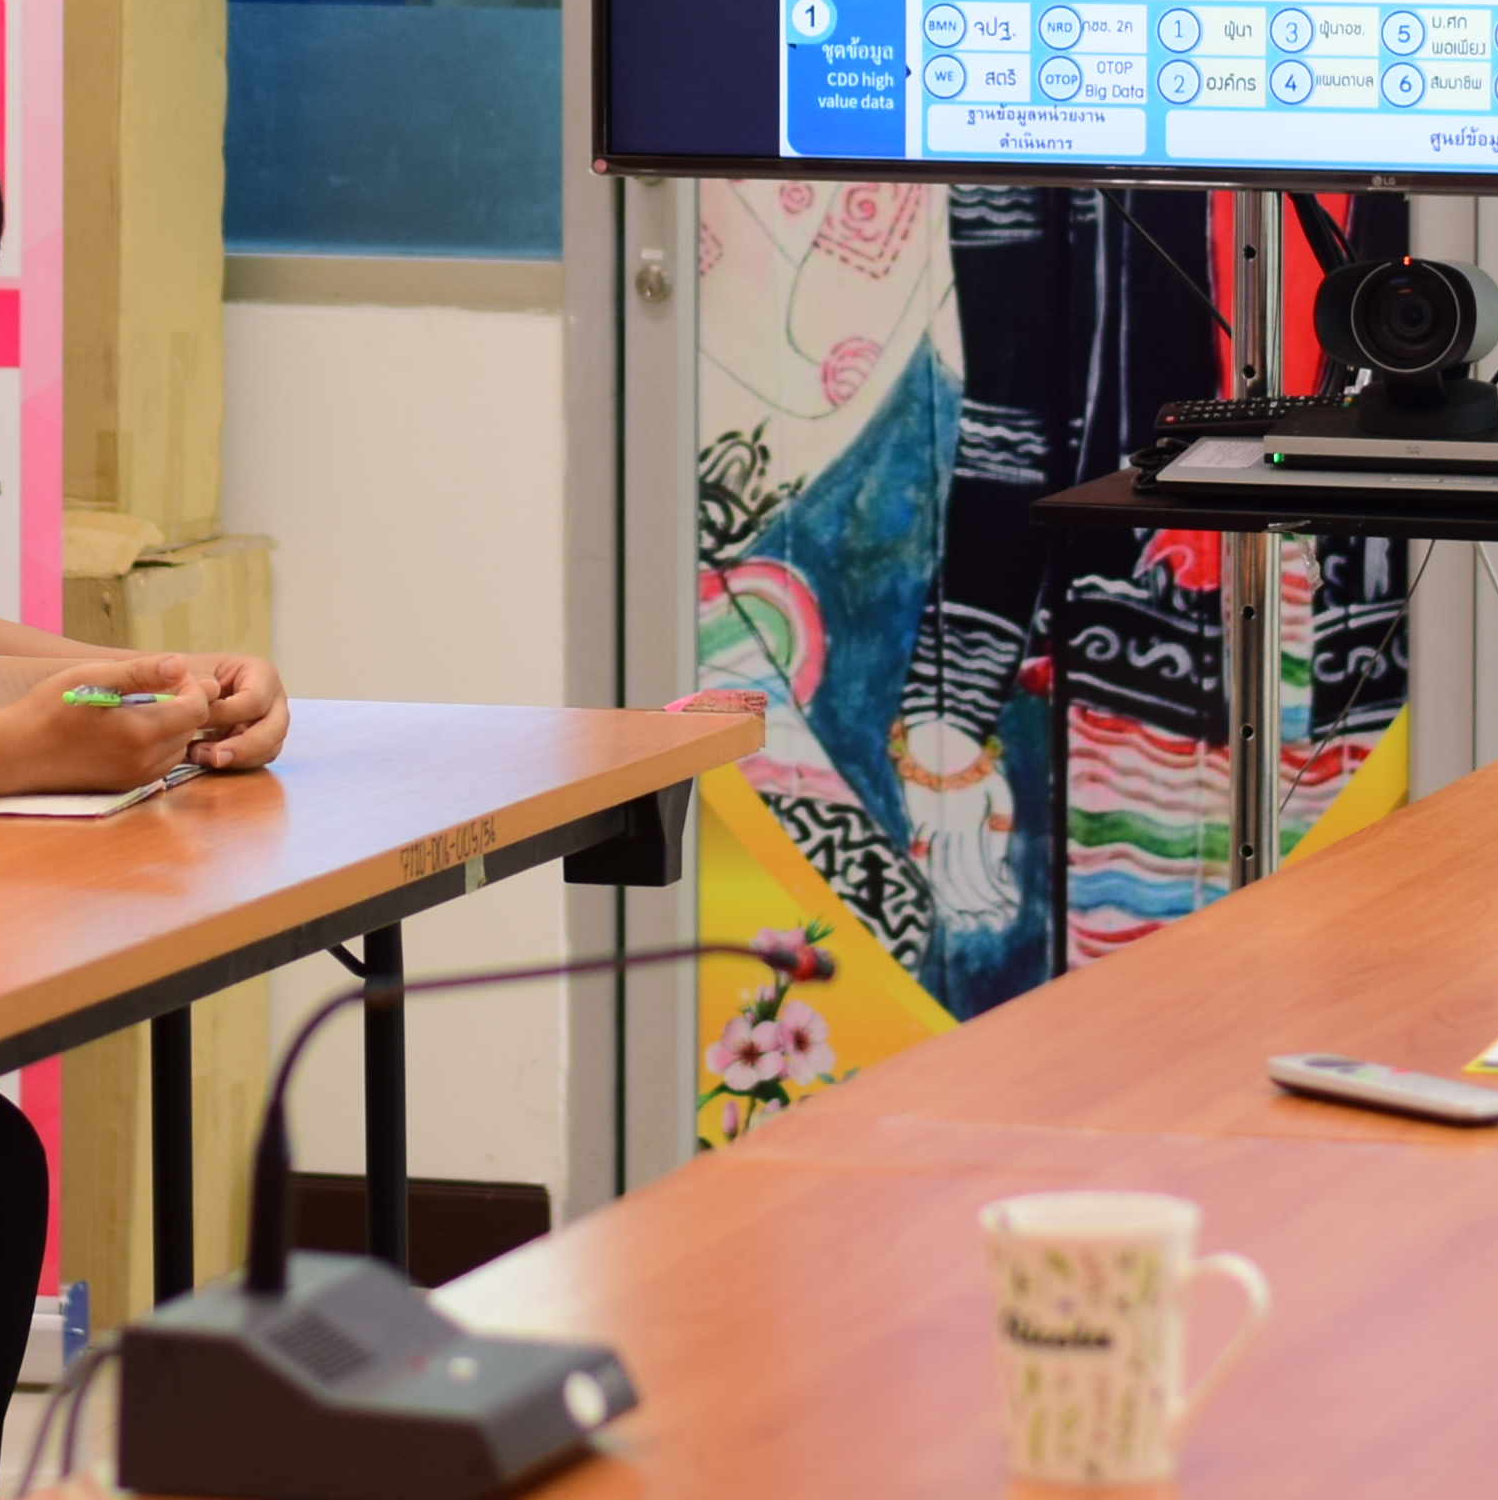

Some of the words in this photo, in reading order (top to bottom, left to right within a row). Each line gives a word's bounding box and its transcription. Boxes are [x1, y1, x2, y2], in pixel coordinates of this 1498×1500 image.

[804, 5, 817, 27] 1
[928, 20, 957, 31] BMN
[1047, 22, 1073, 33] NRD
[821, 39, 894, 66] ชุดข้อมูล
[934, 70, 954, 82] WE
[1096, 60, 1133, 75] OTOP
[827, 72, 857, 88] CDD
[861, 71, 894, 92] high
[985, 68, 1016, 87] สตรี
[1045, 74, 1078, 86] OTOP
[1399, 75, 1412, 93] 6
[1085, 84, 1107, 101] Big
[1111, 85, 1144, 99] Data
[817, 94, 856, 110] value
[860, 93, 895, 110] data
[1383, 176, 1396, 186] LG
